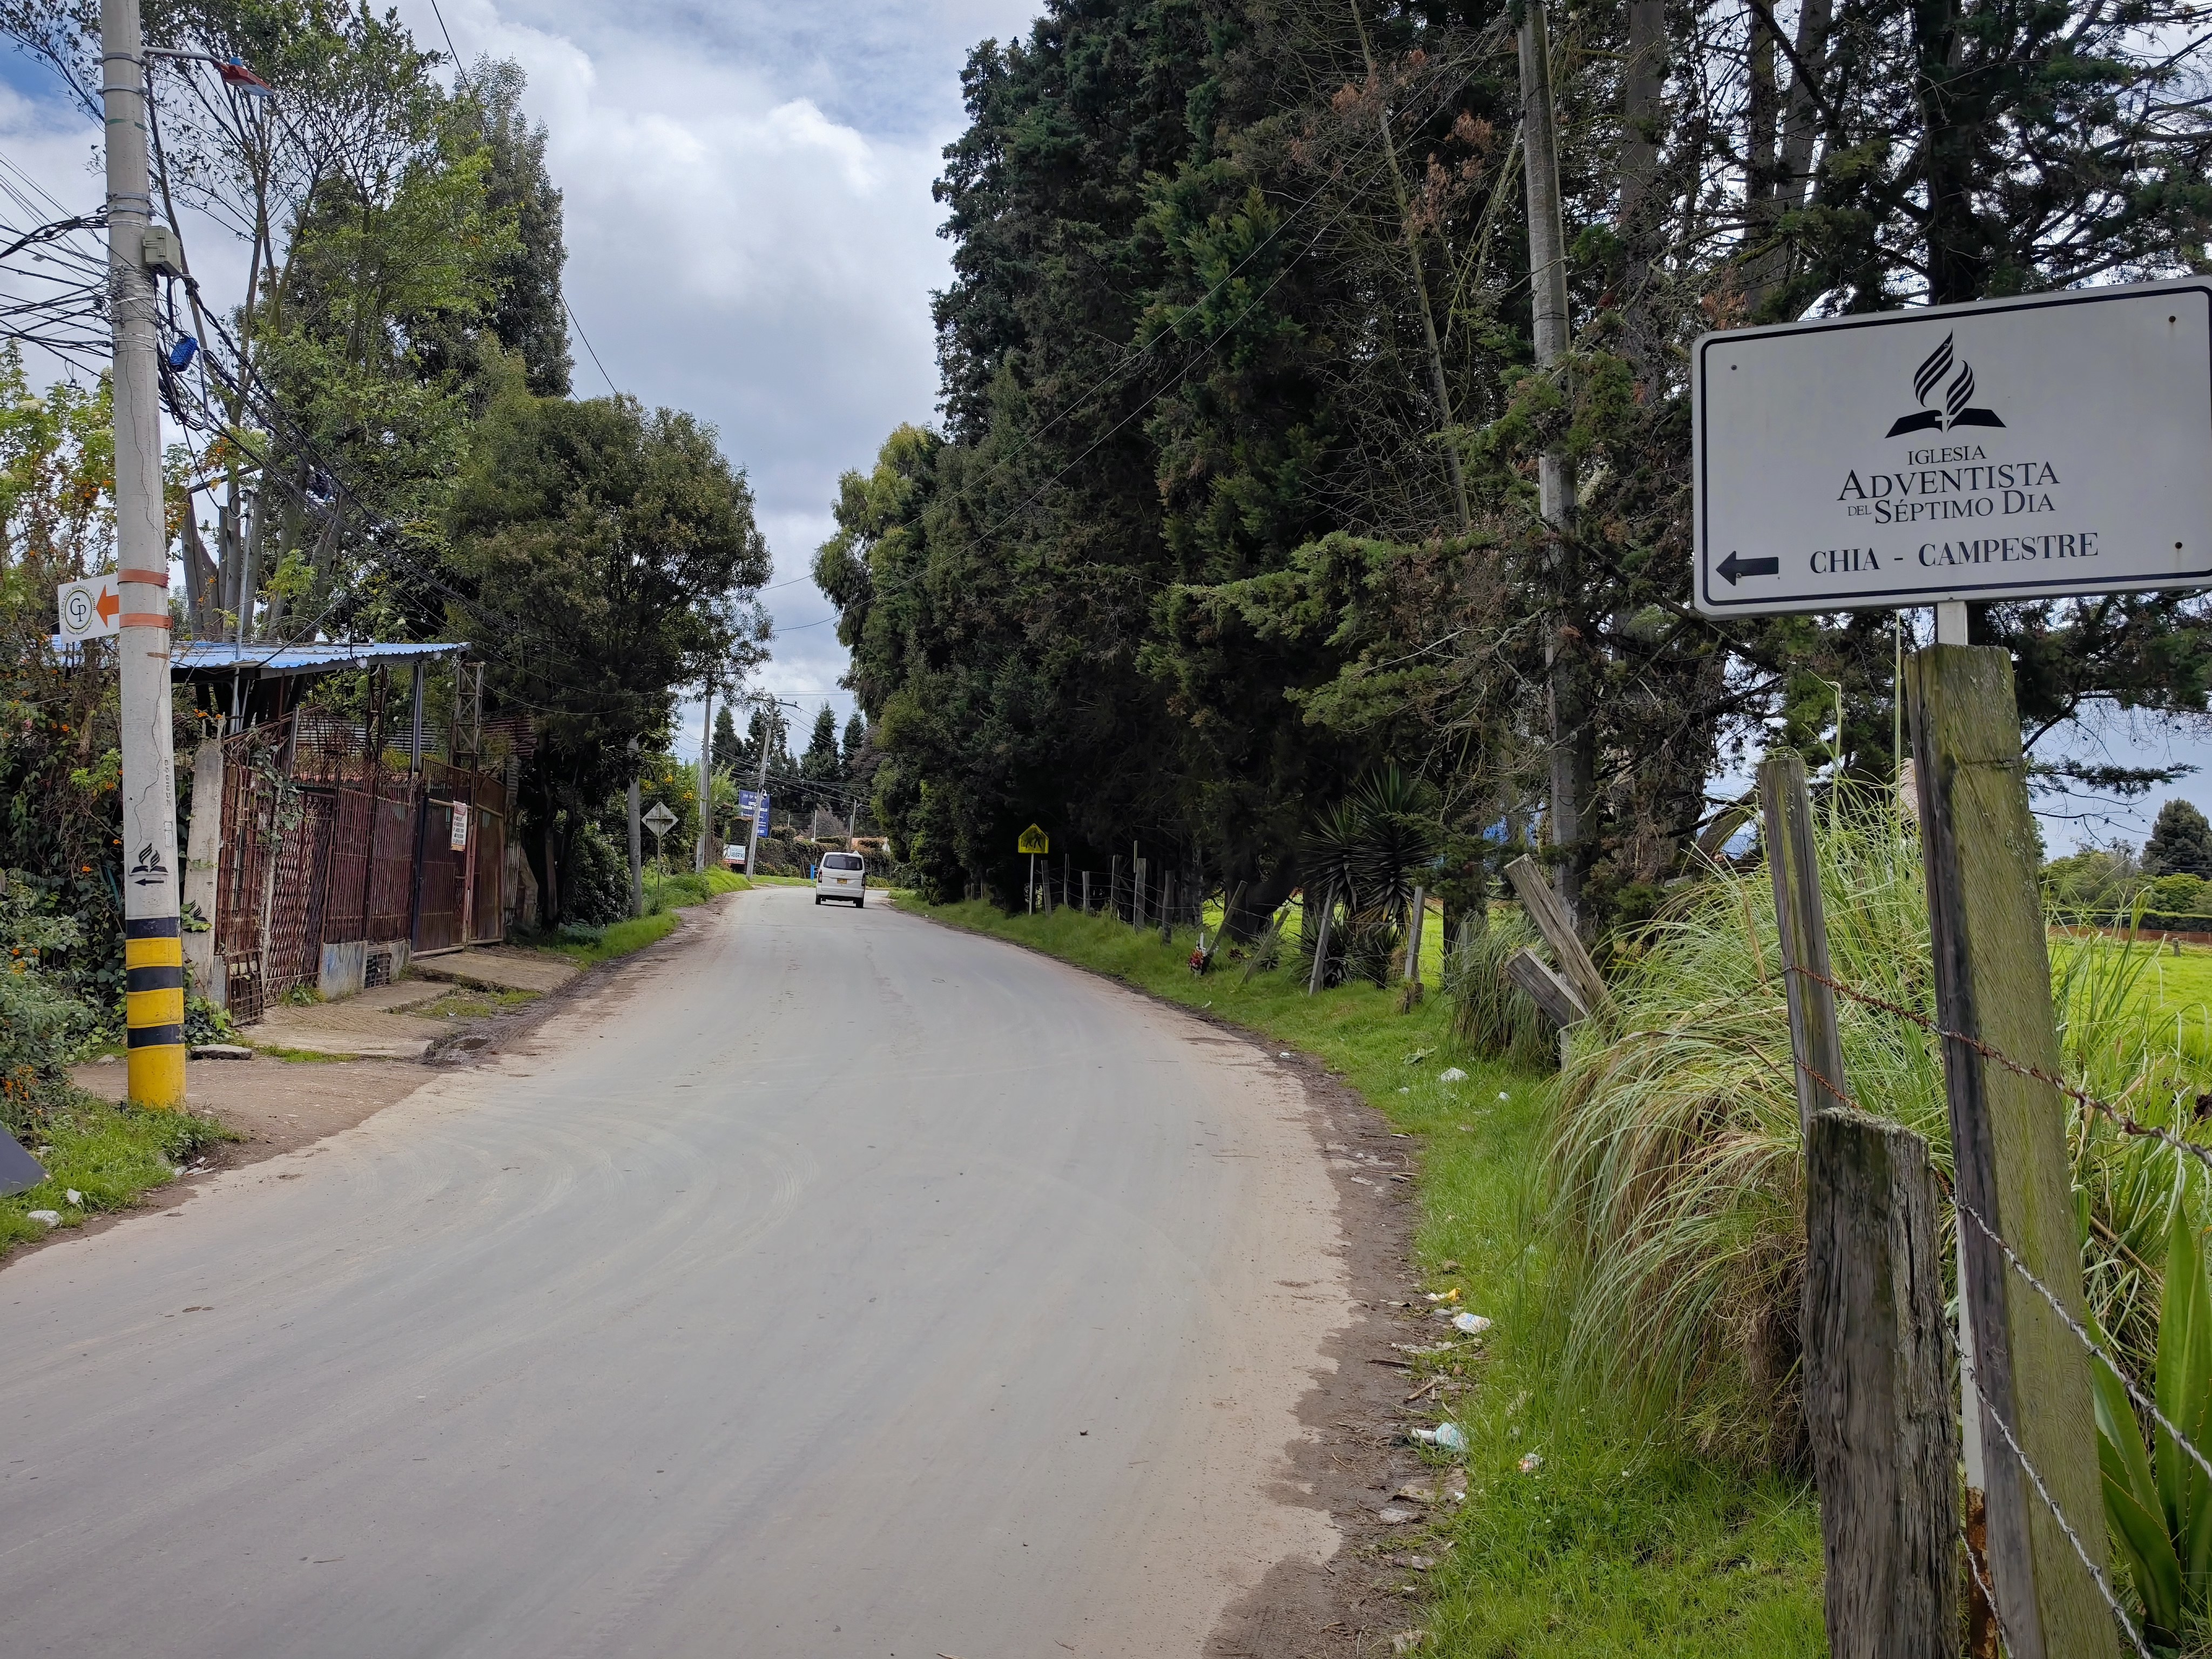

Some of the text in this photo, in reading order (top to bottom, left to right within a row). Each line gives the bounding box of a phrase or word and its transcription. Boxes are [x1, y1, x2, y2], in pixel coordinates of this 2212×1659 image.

[1907, 445, 1987, 466] IGLESIA
[1837, 461, 2061, 501] ADVENTISTA
[1848, 490, 2056, 524] DEL SÉPTIMO DIA
[1810, 548, 1880, 574] CHIA
[1918, 532, 2098, 567] CAMPESTRE
